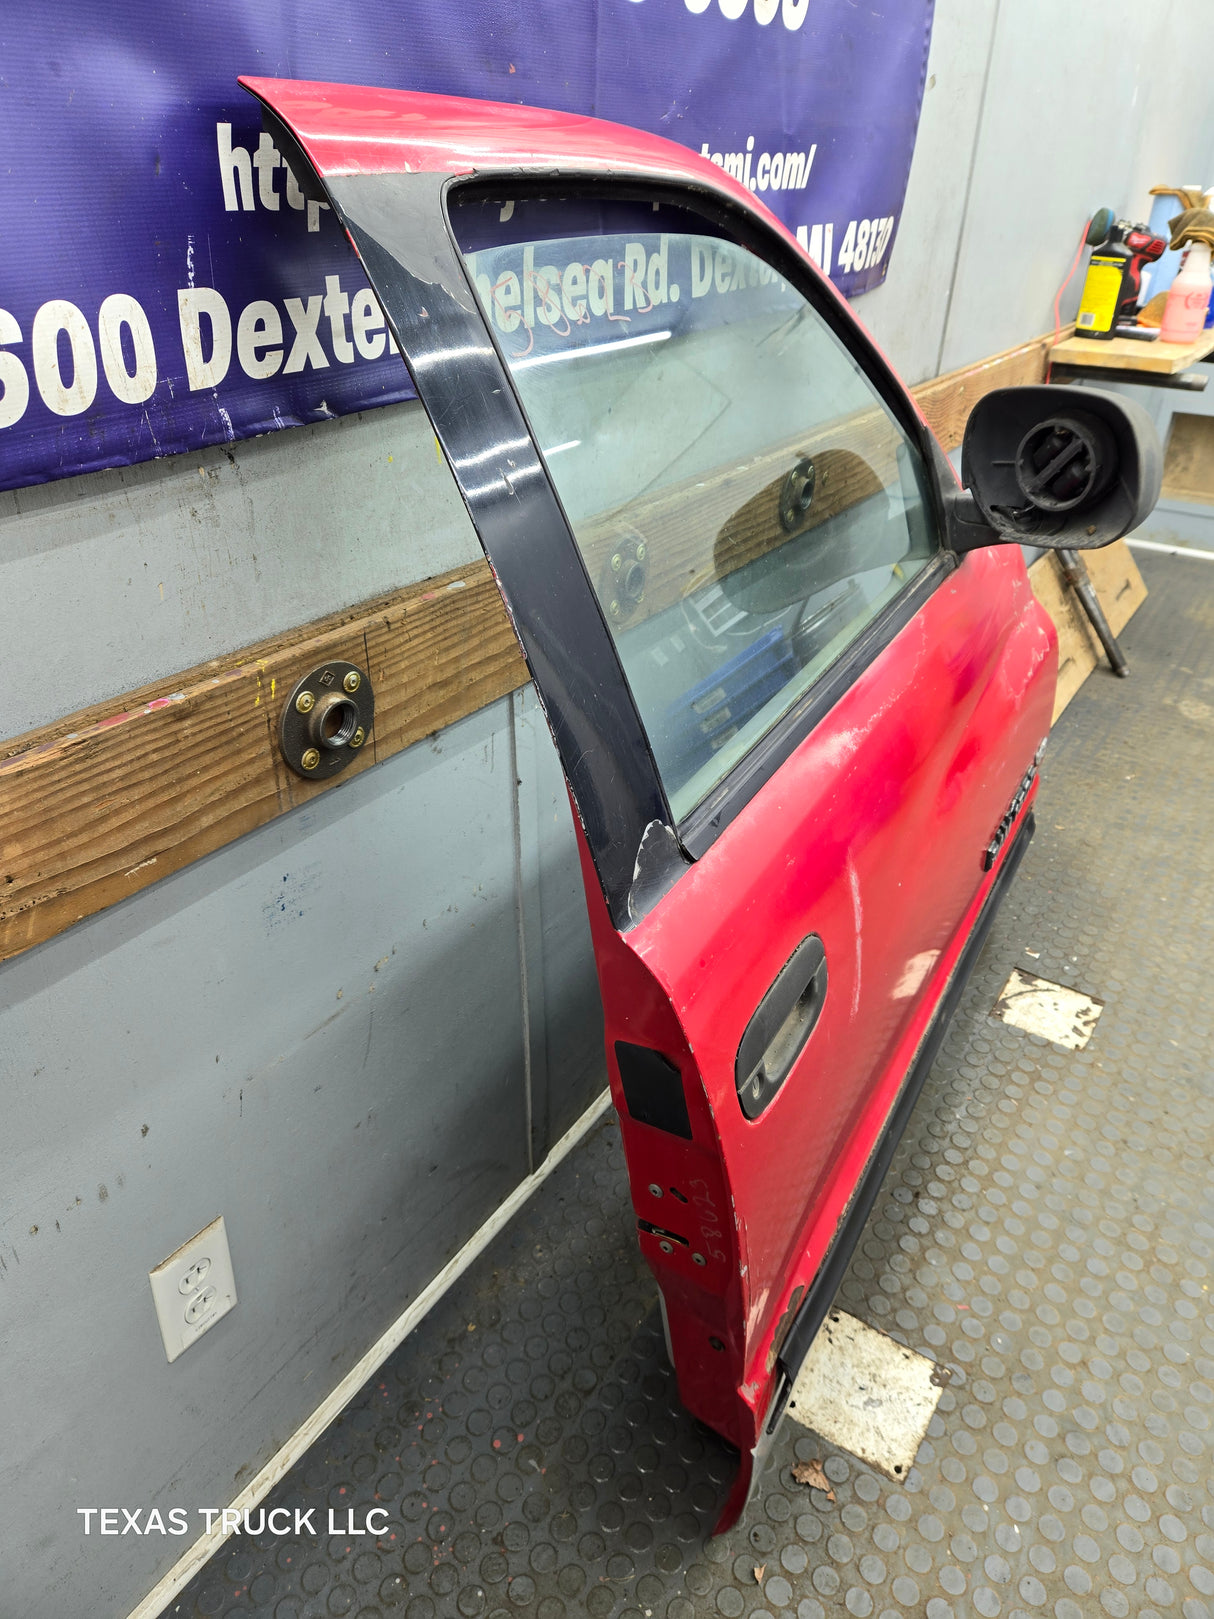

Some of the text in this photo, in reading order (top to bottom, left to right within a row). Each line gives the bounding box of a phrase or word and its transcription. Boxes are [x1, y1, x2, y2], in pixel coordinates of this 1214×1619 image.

[177, 275, 402, 391] Dexte
[624, 233, 680, 310] Rd.
[796, 223, 834, 275] MI
